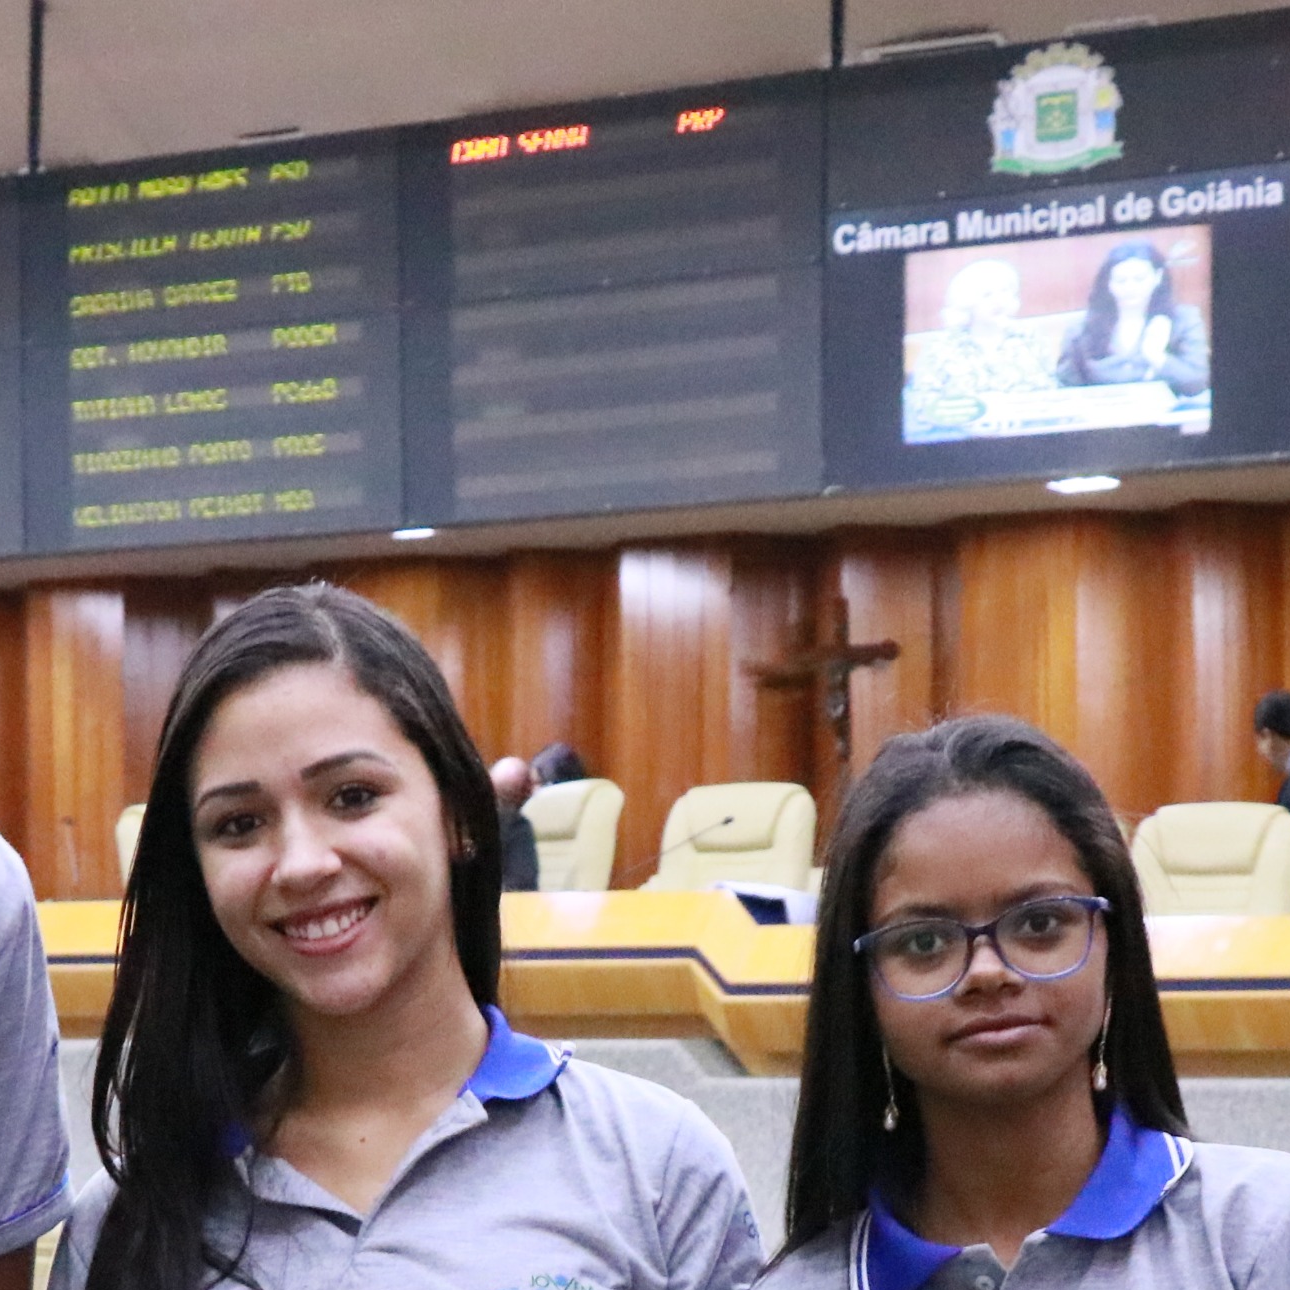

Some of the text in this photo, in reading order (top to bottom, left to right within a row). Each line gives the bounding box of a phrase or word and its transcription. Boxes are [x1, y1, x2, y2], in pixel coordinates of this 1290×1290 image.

[833, 177, 1285, 254] Câmara Municipal de Goiânia
